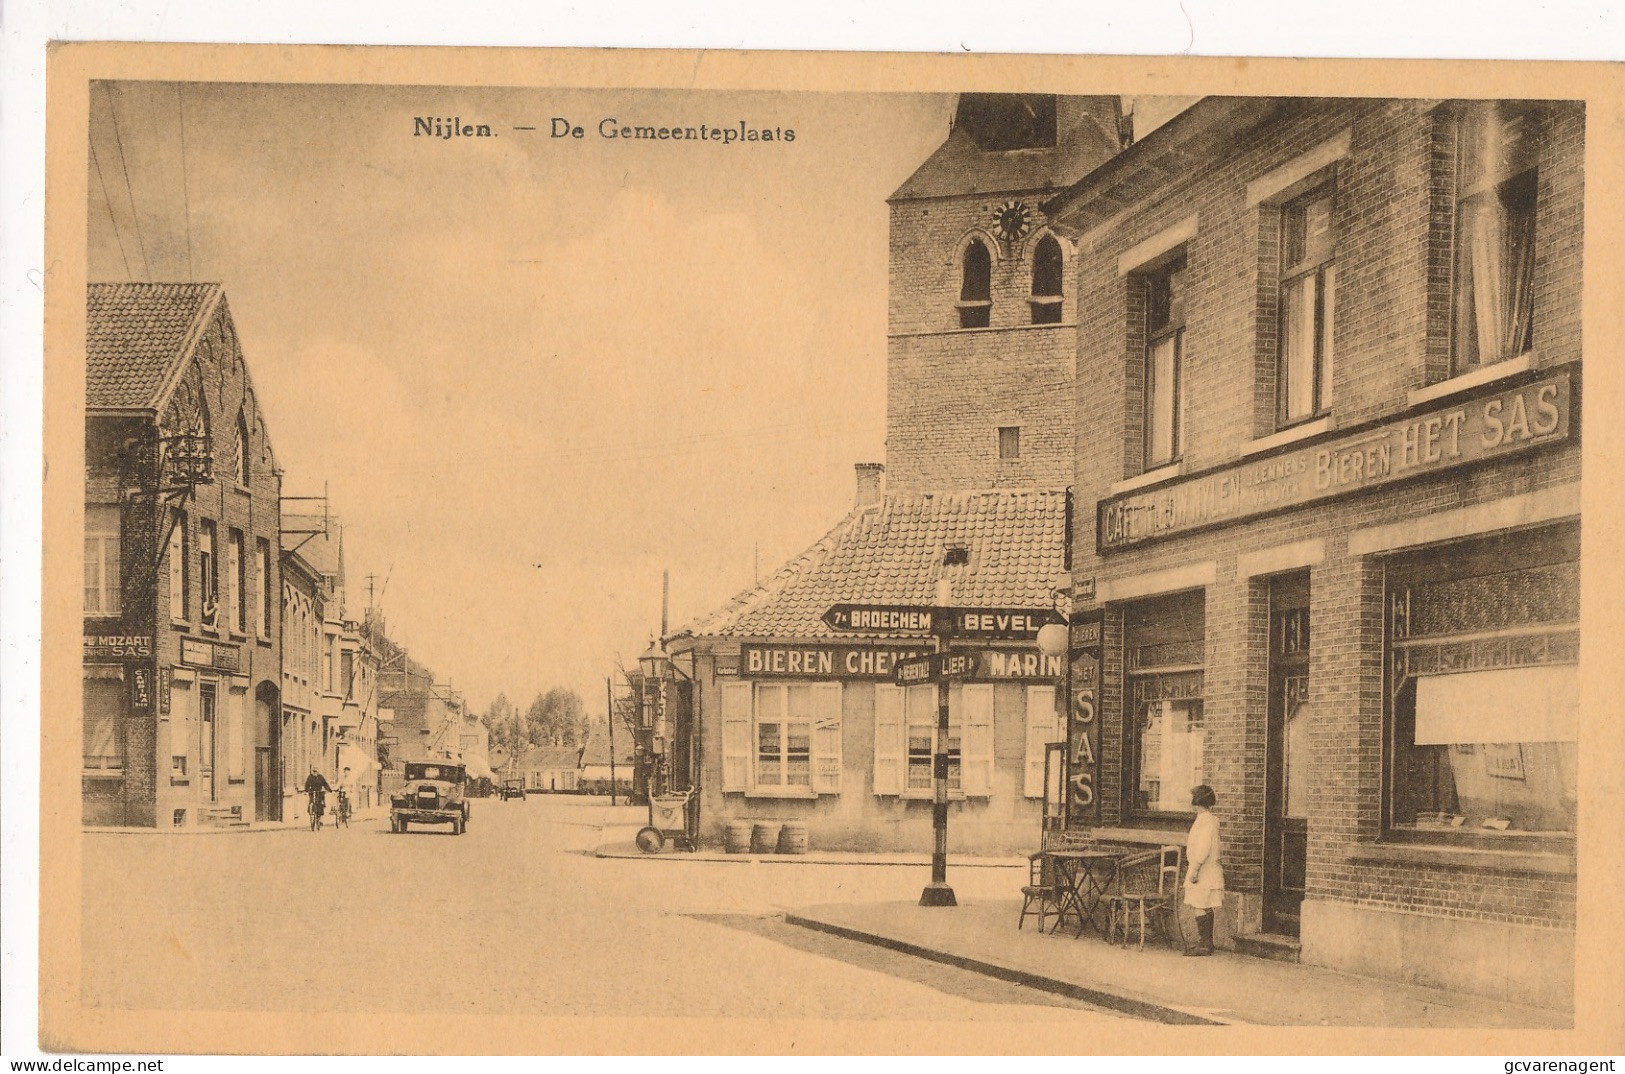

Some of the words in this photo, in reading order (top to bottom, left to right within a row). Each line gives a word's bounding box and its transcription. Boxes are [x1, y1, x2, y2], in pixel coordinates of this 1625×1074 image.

[1400, 410, 1466, 468] HET
[1481, 385, 1559, 449] SAS
[851, 611, 932, 630] BROECHEM
[964, 613, 1039, 631] BEVEL
[98, 636, 150, 646] MOZART
[111, 646, 150, 657] SAS
[749, 650, 833, 674] BIEREN
[990, 653, 1062, 677] MARIN
[942, 656, 965, 675] LIER
[134, 670, 148, 702] CAMPINA
[1073, 690, 1095, 805] SAS
